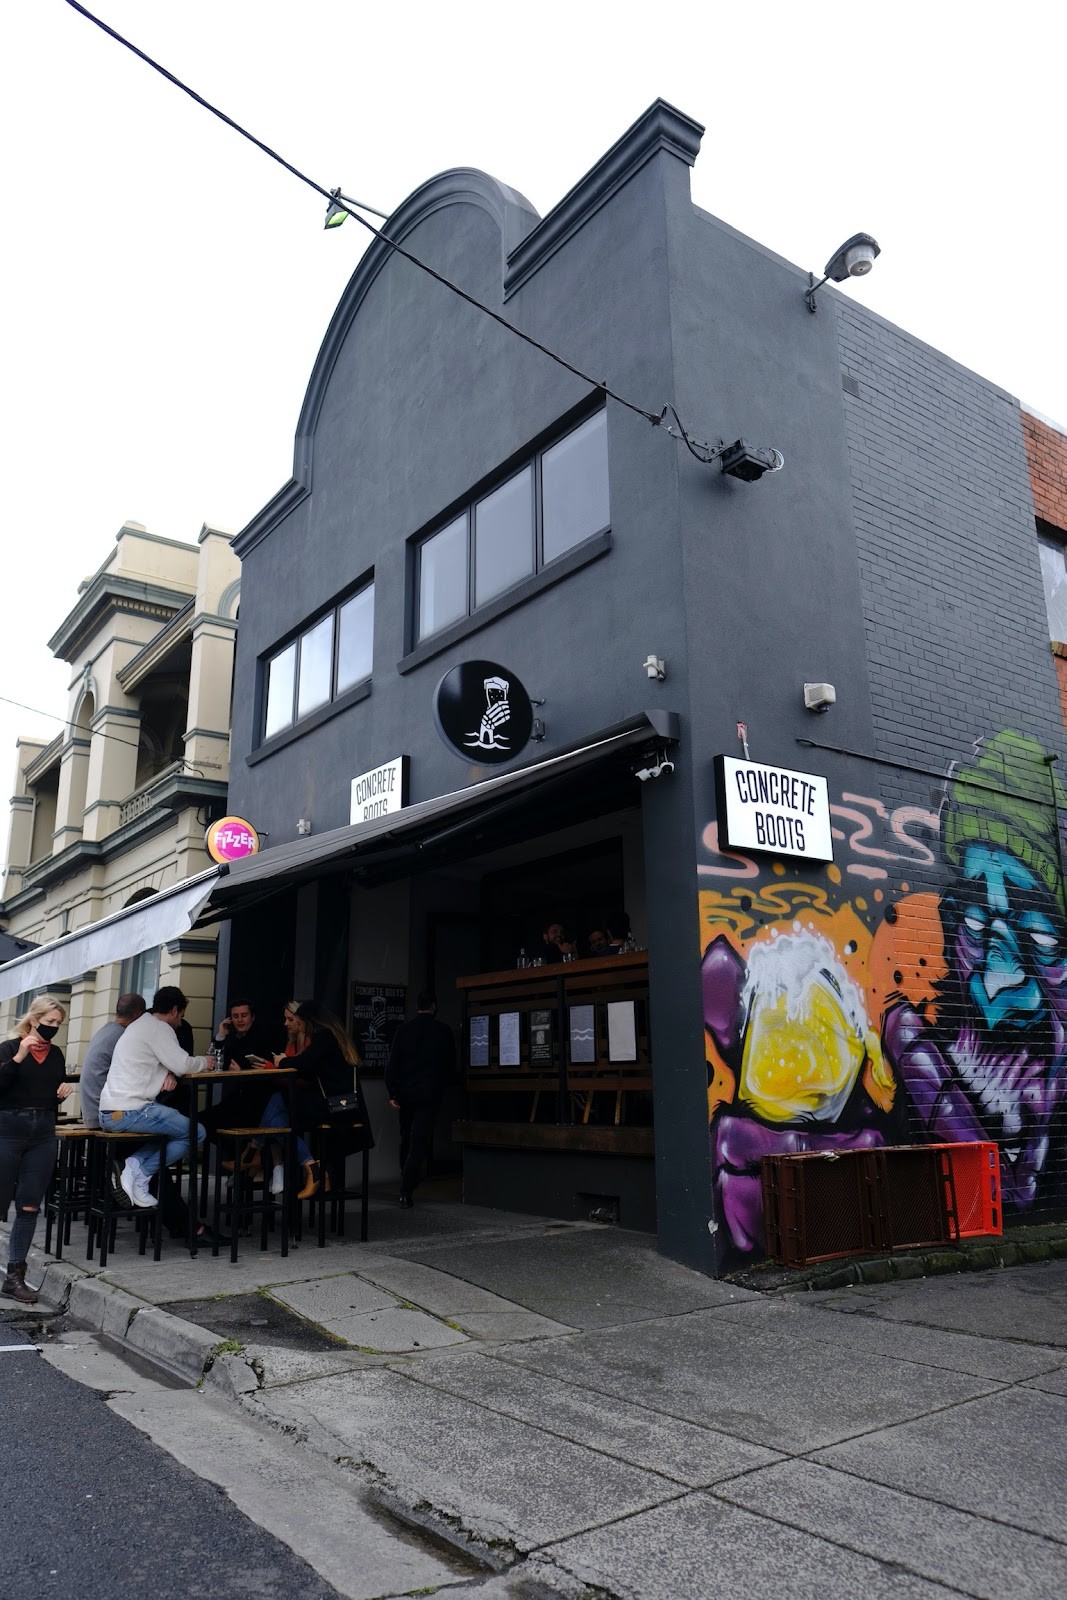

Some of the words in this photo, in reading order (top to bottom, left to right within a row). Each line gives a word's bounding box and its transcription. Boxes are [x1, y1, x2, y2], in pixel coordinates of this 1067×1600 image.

[356, 767, 396, 805] CONCRETE
[736, 770, 816, 816] CONCRETE
[213, 830, 256, 850] FIZZER
[755, 812, 805, 851] BOOTS
[356, 986, 384, 996] CONCRETE
[385, 988, 404, 997] BOOTS
